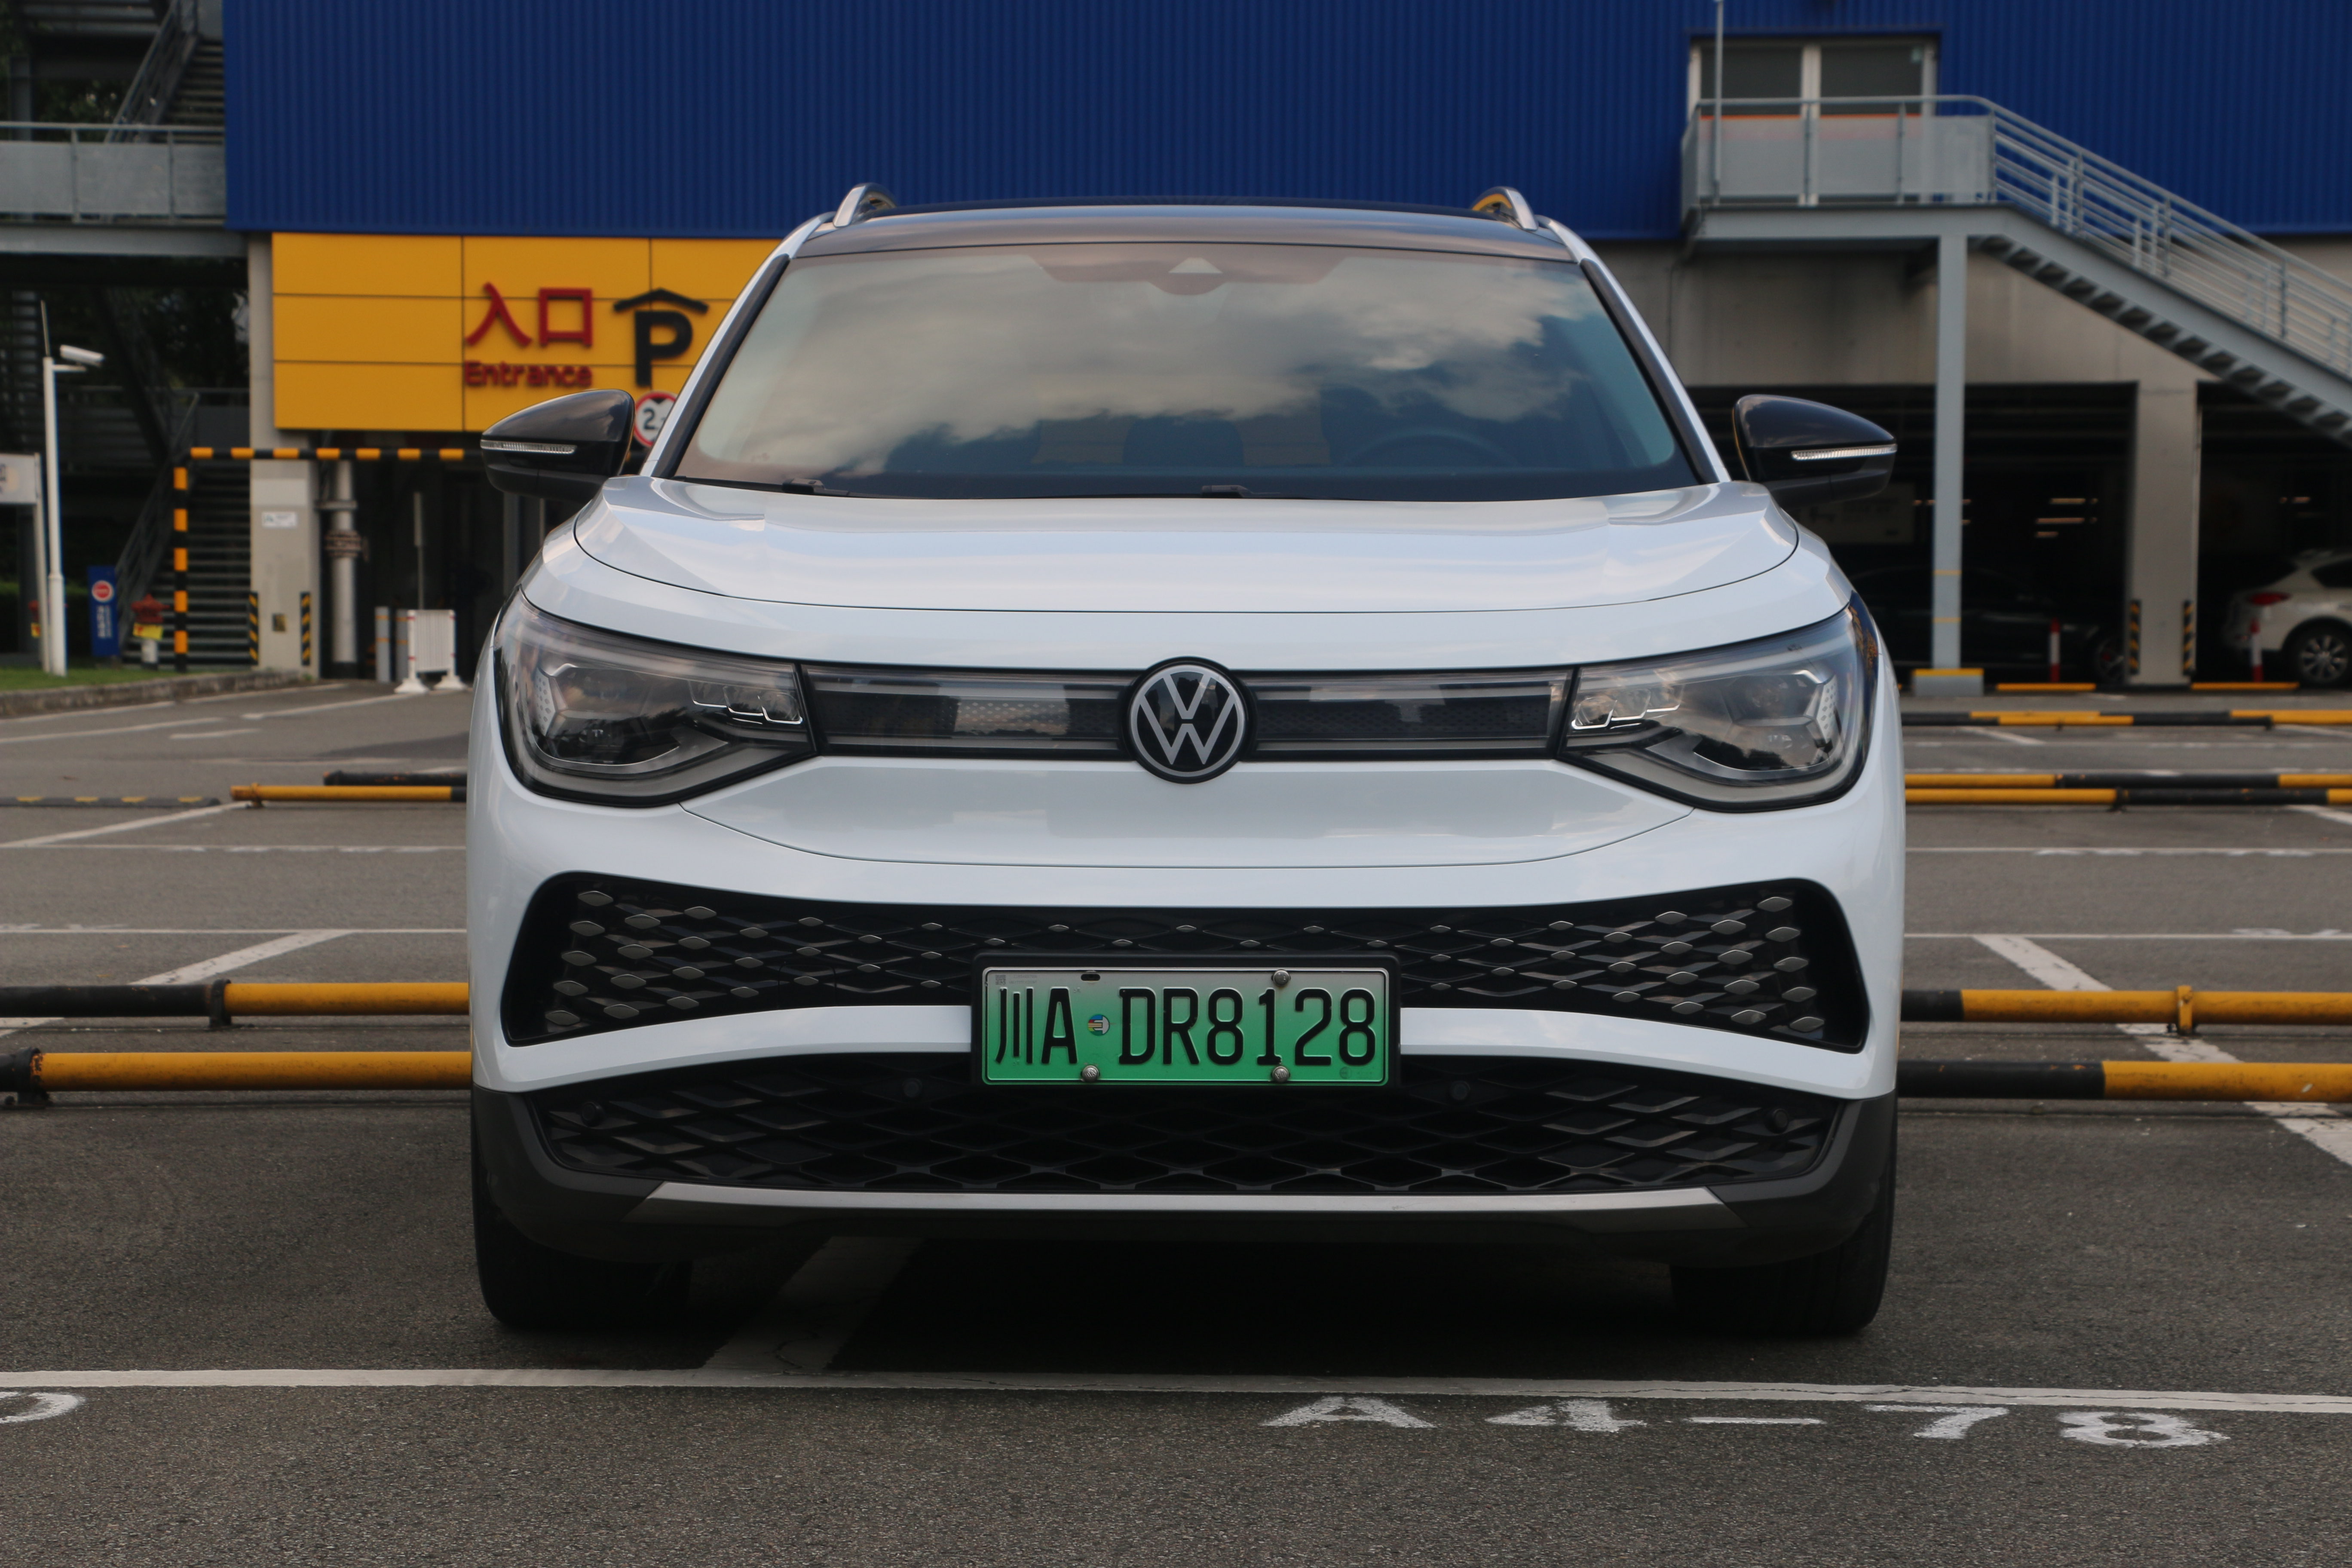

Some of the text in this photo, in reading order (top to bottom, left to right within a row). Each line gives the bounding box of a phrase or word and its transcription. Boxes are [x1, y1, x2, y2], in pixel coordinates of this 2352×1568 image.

[465, 282, 593, 348] 入口
[634, 310, 693, 387] P
[465, 360, 592, 386] Entrance
[1135, 668, 1239, 767] VW
[1118, 988, 1376, 1066] DR8128
